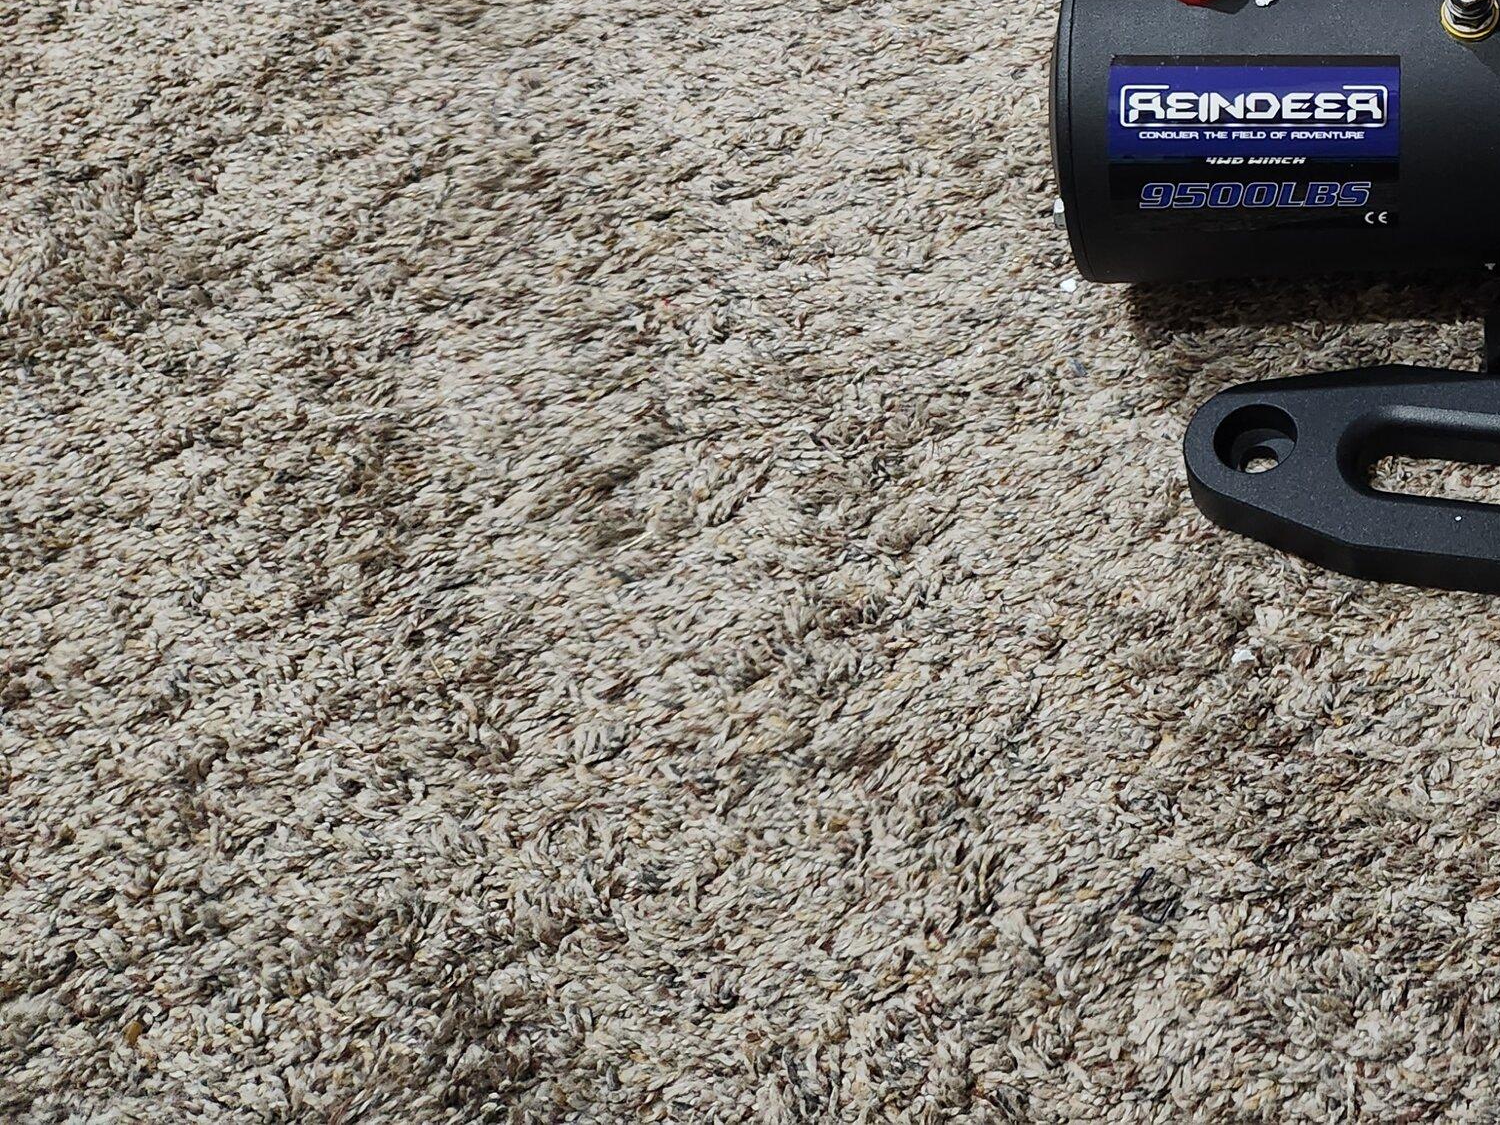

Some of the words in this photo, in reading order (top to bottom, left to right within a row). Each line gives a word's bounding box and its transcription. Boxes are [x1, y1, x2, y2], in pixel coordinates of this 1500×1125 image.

[1129, 92, 1382, 123] REINDEER
[1138, 131, 1199, 140] CONQUER
[1204, 131, 1229, 140] THE
[1231, 131, 1266, 140] FIELD
[1270, 131, 1287, 140] OF
[1291, 131, 1365, 140] ADVENTURE
[1139, 181, 1371, 209] 9500LBS
[1364, 211, 1388, 224] CE
